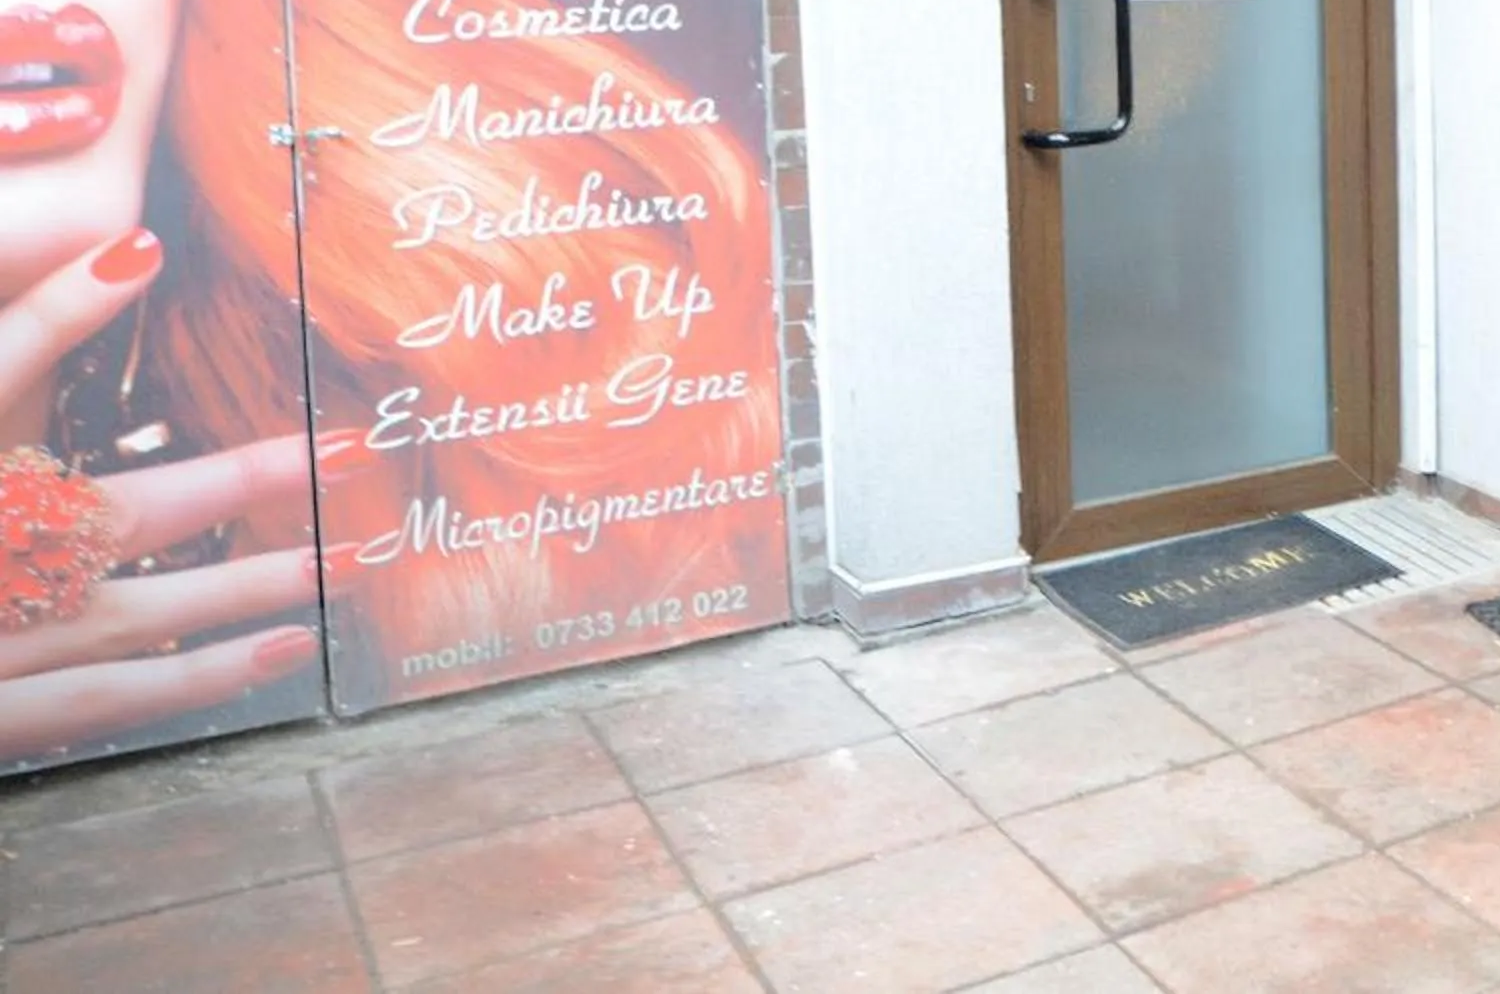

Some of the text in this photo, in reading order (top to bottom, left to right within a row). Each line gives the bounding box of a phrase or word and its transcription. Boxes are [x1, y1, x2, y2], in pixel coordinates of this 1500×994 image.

[369, 72, 720, 150] Manichiura
[392, 171, 708, 248] Pedichiura
[396, 263, 715, 348] Make Up
[365, 354, 749, 449] Extensii Gene
[355, 468, 769, 565] Micropigmentare
[402, 585, 748, 677] mobil: 0733 412 022
